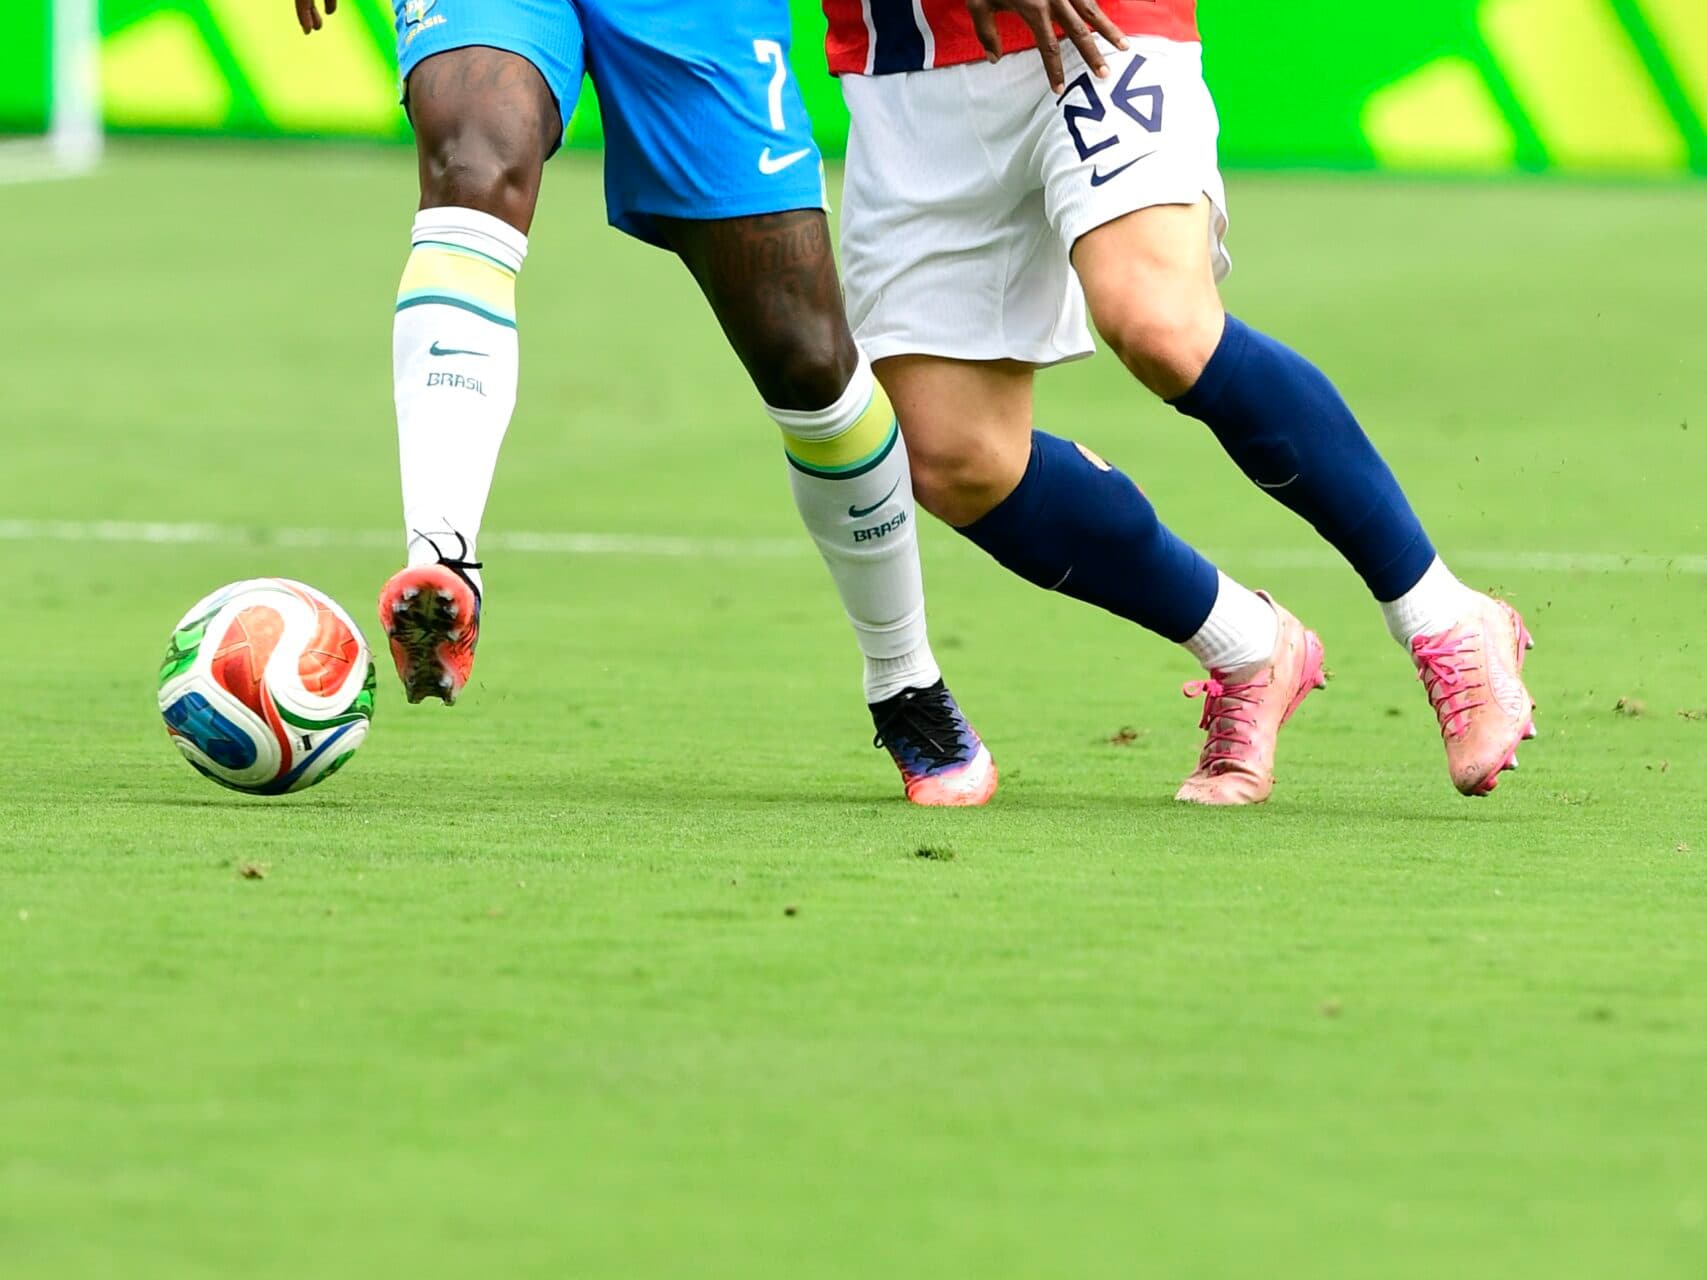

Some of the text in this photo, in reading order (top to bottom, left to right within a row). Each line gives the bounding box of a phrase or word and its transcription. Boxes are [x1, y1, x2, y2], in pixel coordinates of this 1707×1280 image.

[753, 39, 787, 131] 7
[1056, 53, 1164, 162] 26
[426, 372, 487, 397] BRASIL
